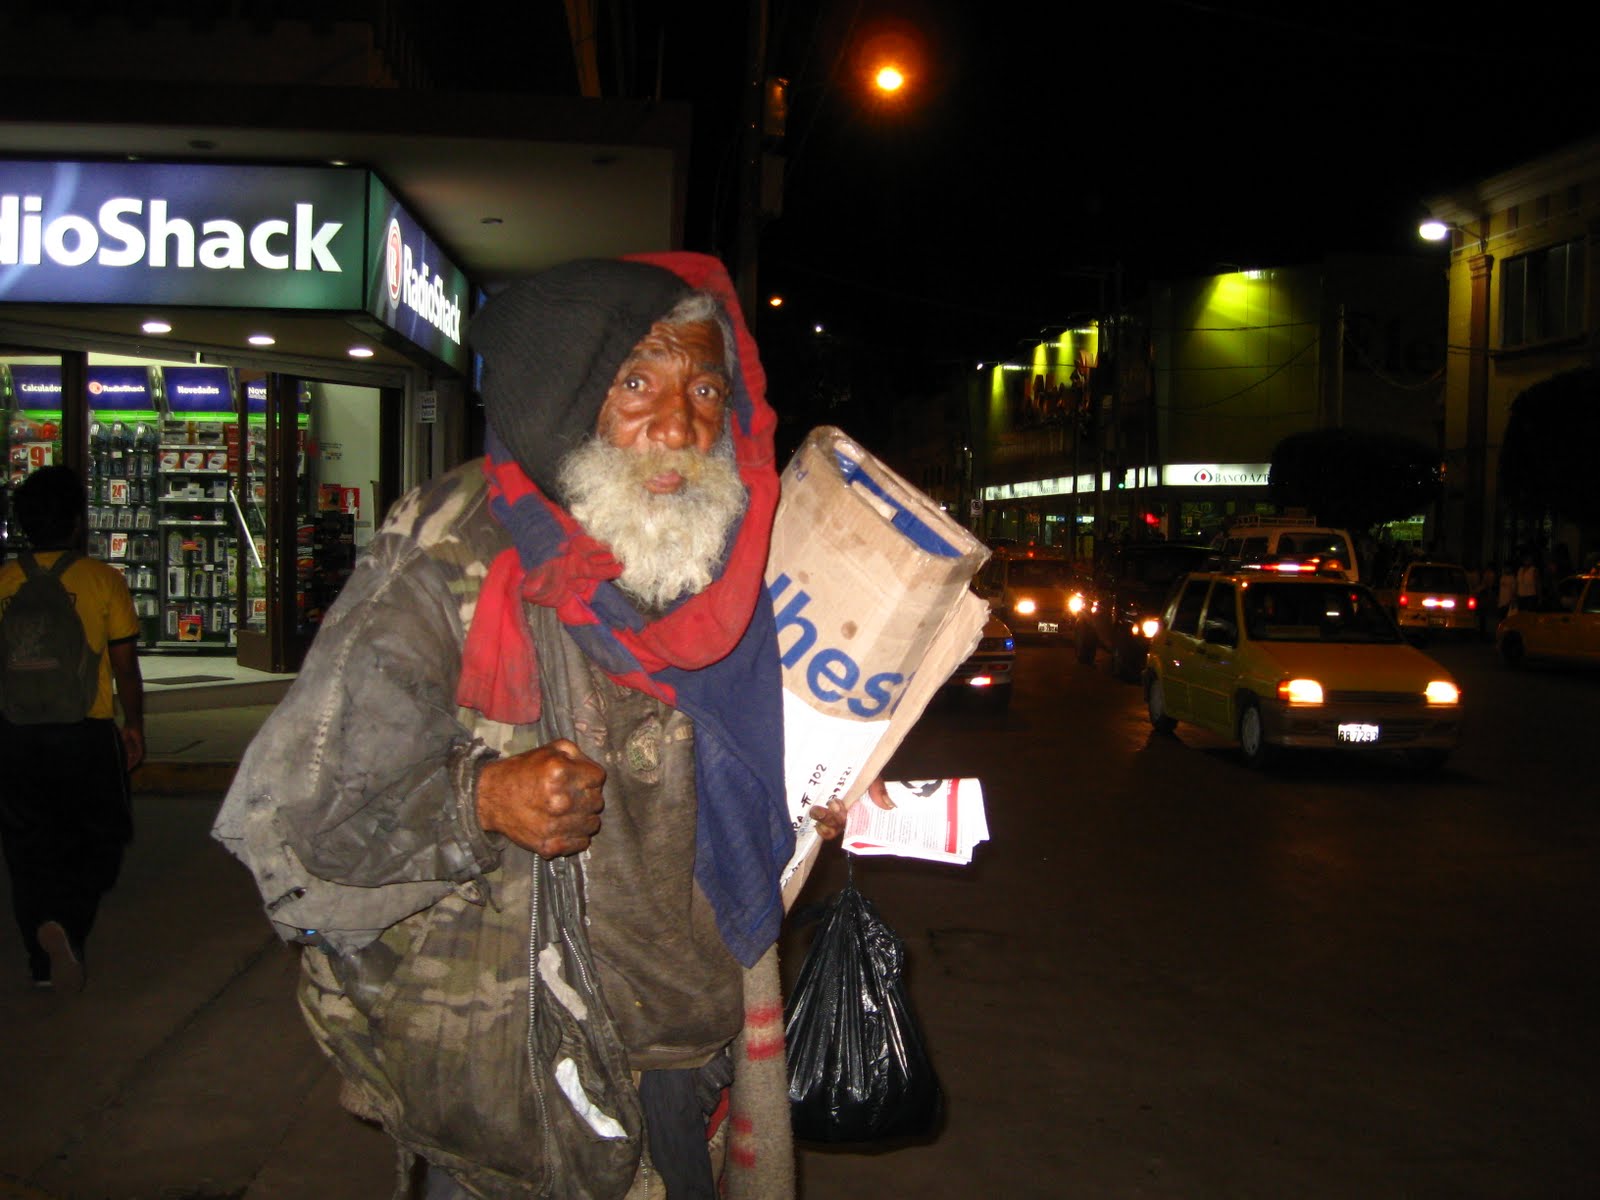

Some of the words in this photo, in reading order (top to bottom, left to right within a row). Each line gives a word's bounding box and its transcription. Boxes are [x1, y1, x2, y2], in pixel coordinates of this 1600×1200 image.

[403, 243, 461, 346] RadioShack
[177, 385, 219, 394] Novedades
[1215, 473, 1247, 483] BANCO
[808, 763, 827, 787] 702
